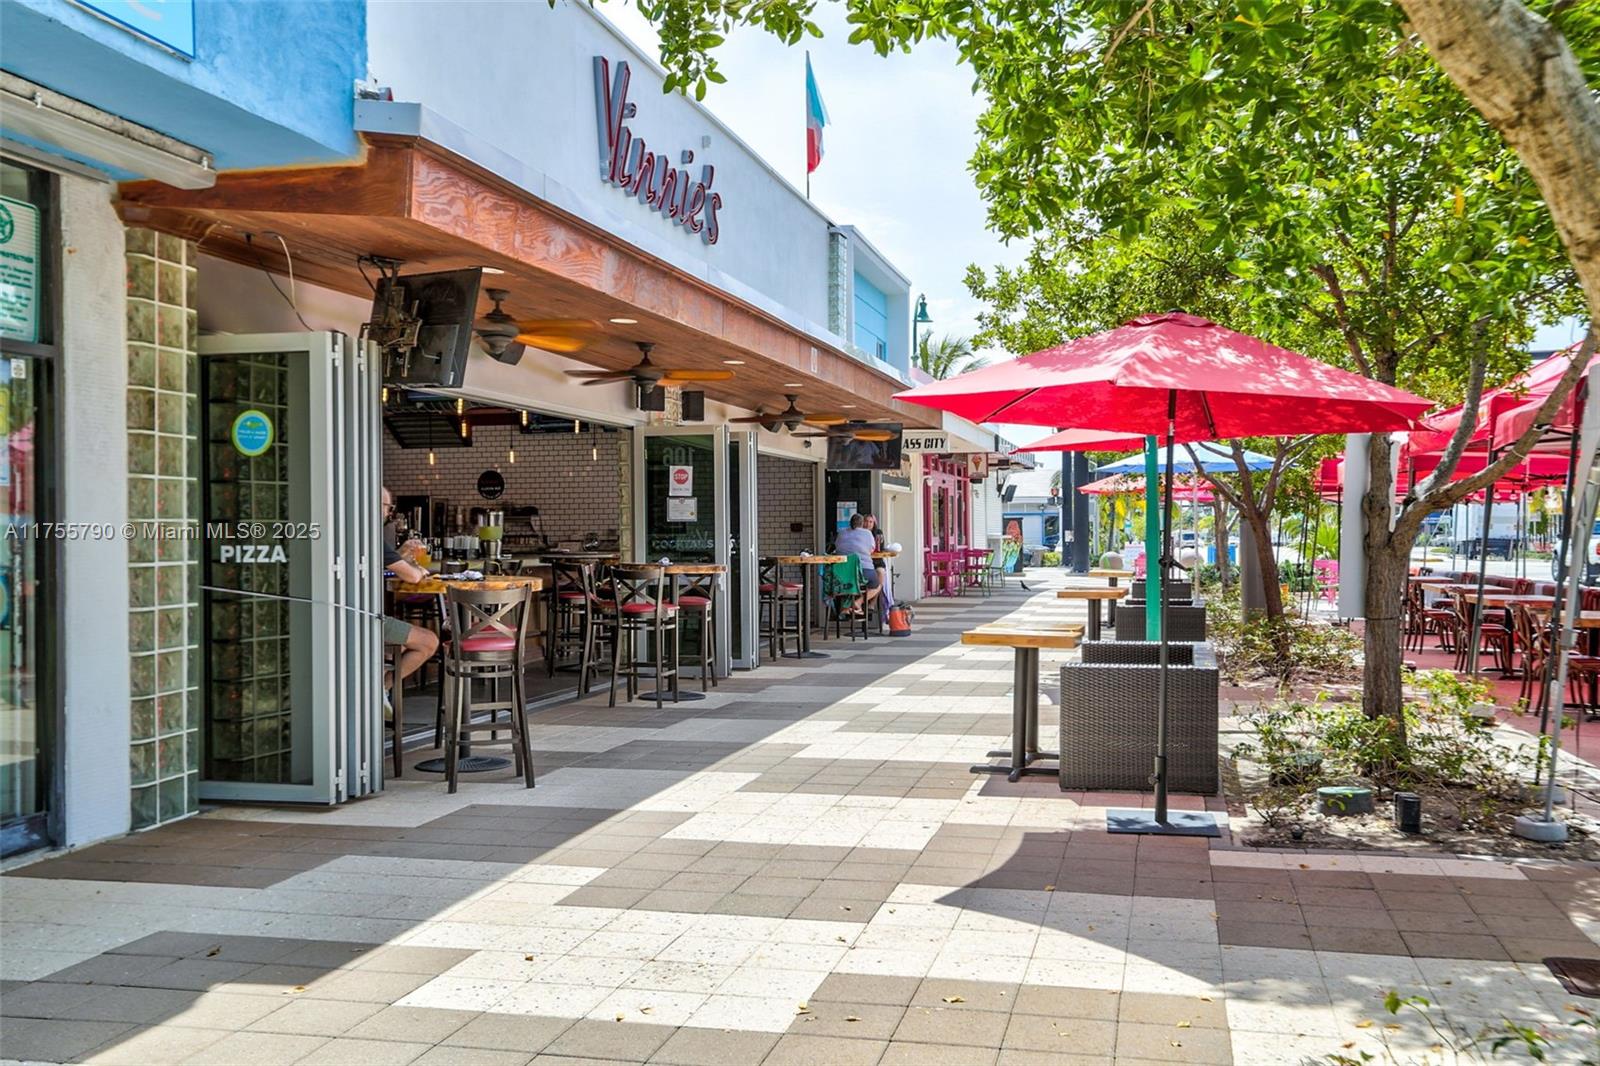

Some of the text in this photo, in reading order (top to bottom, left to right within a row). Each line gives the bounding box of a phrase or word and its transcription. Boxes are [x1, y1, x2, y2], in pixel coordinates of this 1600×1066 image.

[593, 56, 722, 245] Vinnie's
[924, 437, 946, 449] CITY
[220, 545, 287, 563] PIZZA
